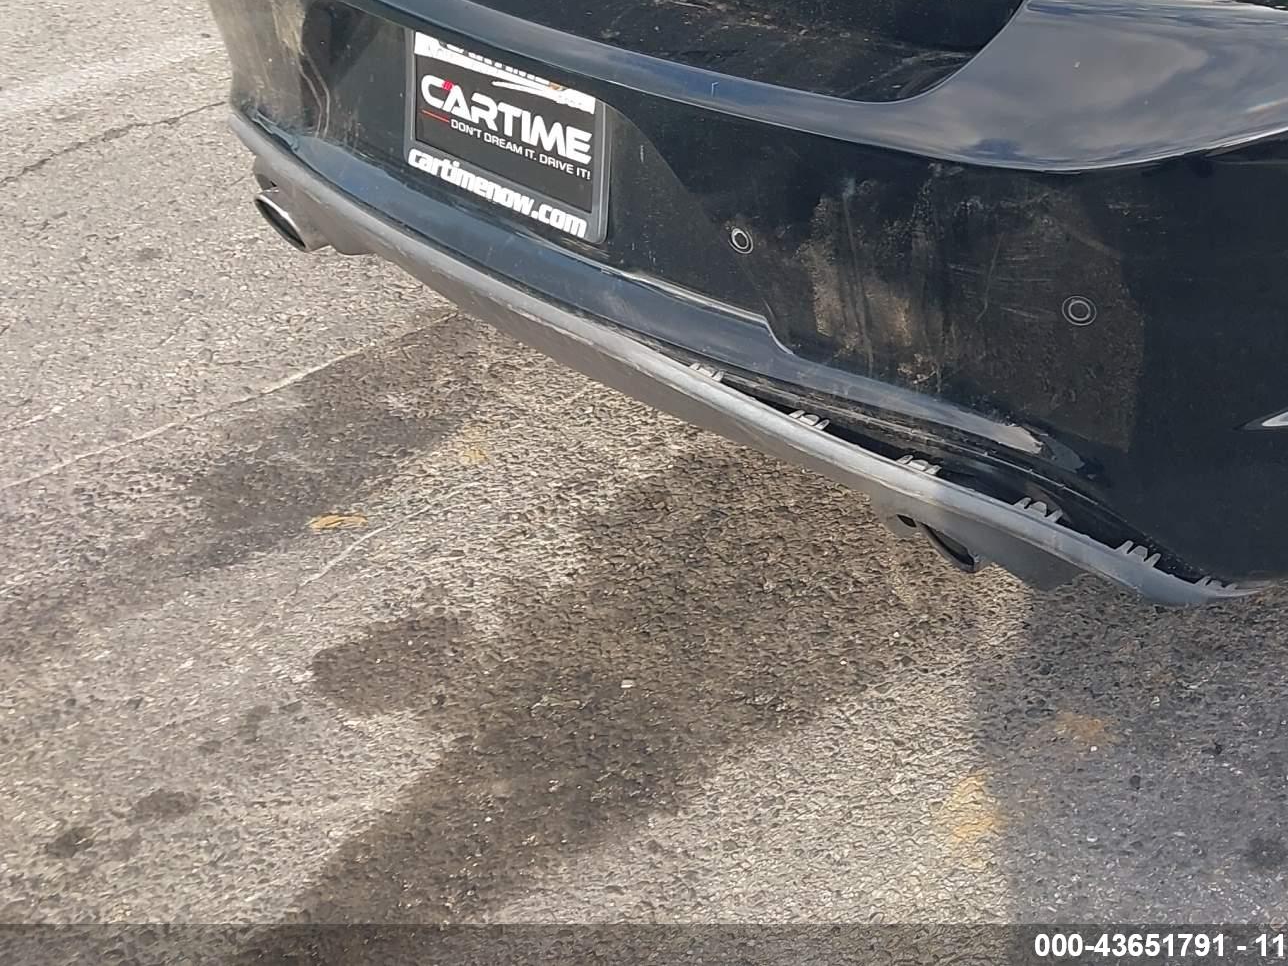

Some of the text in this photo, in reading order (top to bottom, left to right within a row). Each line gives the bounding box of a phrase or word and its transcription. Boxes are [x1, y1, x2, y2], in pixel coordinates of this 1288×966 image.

[420, 74, 593, 165] CARTIME
[450, 118, 482, 139] DON'T
[484, 132, 523, 155] DREAM
[539, 153, 574, 176] DRIVE
[576, 165, 591, 180] IT!
[408, 148, 588, 239] cartimenow.com
